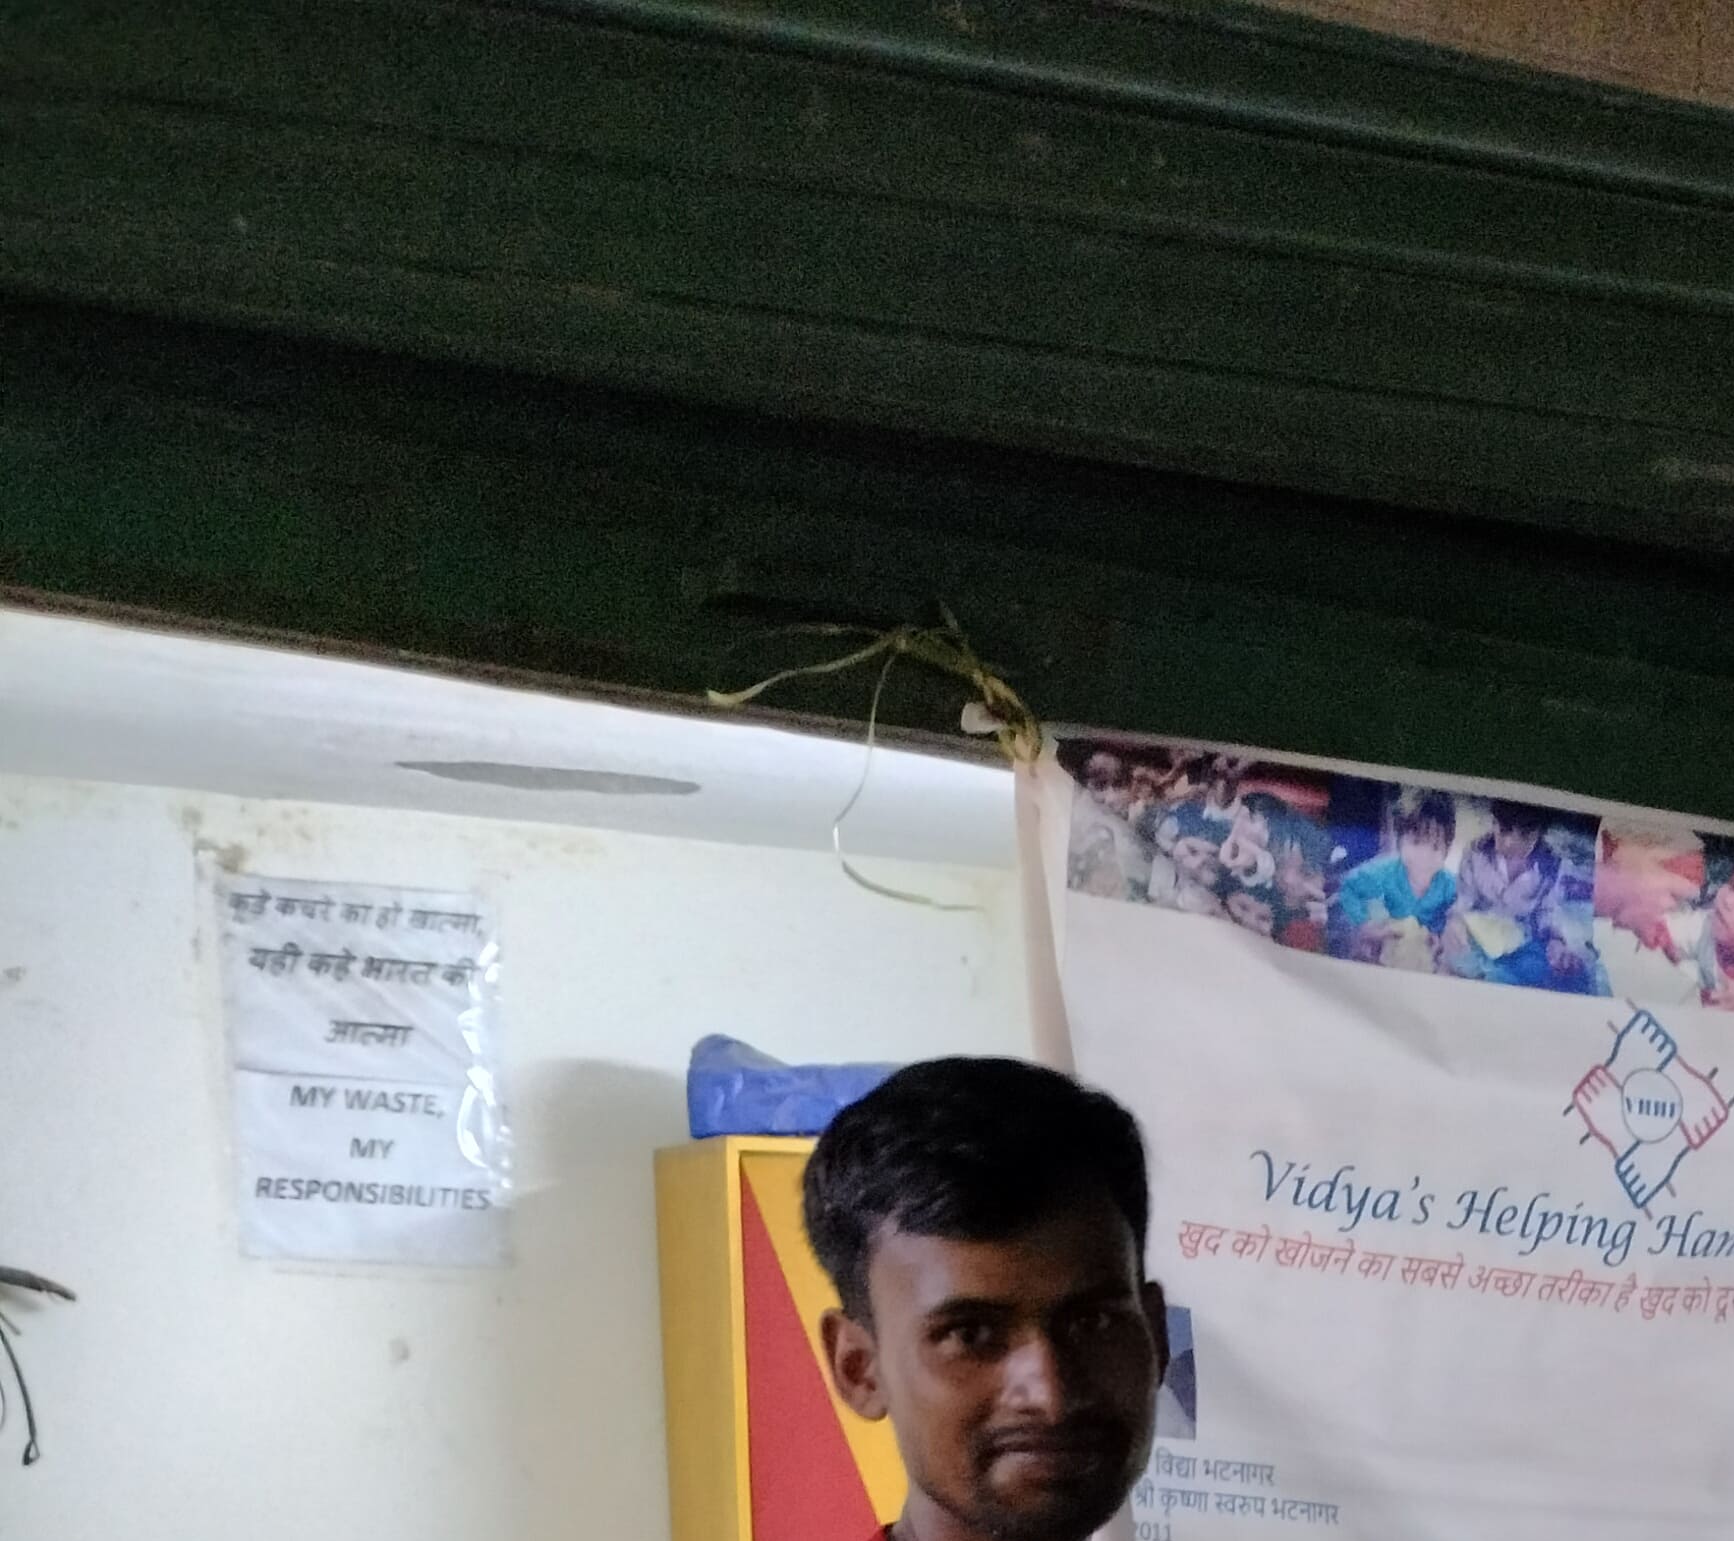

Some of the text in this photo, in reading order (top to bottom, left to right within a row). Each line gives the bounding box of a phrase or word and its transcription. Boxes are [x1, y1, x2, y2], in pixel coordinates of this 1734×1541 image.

[340, 903, 373, 924] का
[361, 956, 437, 985] भारत
[290, 1085, 447, 1119] MY WASTE,
[349, 1138, 395, 1159] MY
[255, 1176, 492, 1211] RESPONSIBILITIES
[1249, 1149, 1436, 1233] Vidya's
[1446, 1186, 1638, 1268] Helping
[1178, 1220, 1230, 1260] खुद
[1232, 1224, 1273, 1263] को
[1275, 1230, 1355, 1275] खोजने
[1358, 1250, 1397, 1281] का
[1400, 1253, 1465, 1289] सबसे
[1468, 1264, 1536, 1298] अच्छा
[1538, 1268, 1615, 1308] तरीका
[1614, 1272, 1637, 1312] है
[1640, 1286, 1681, 1320] खुद
[1682, 1277, 1712, 1314] को
[1203, 1459, 1275, 1486] भटनागर
[1271, 1497, 1339, 1526] भटनागर
